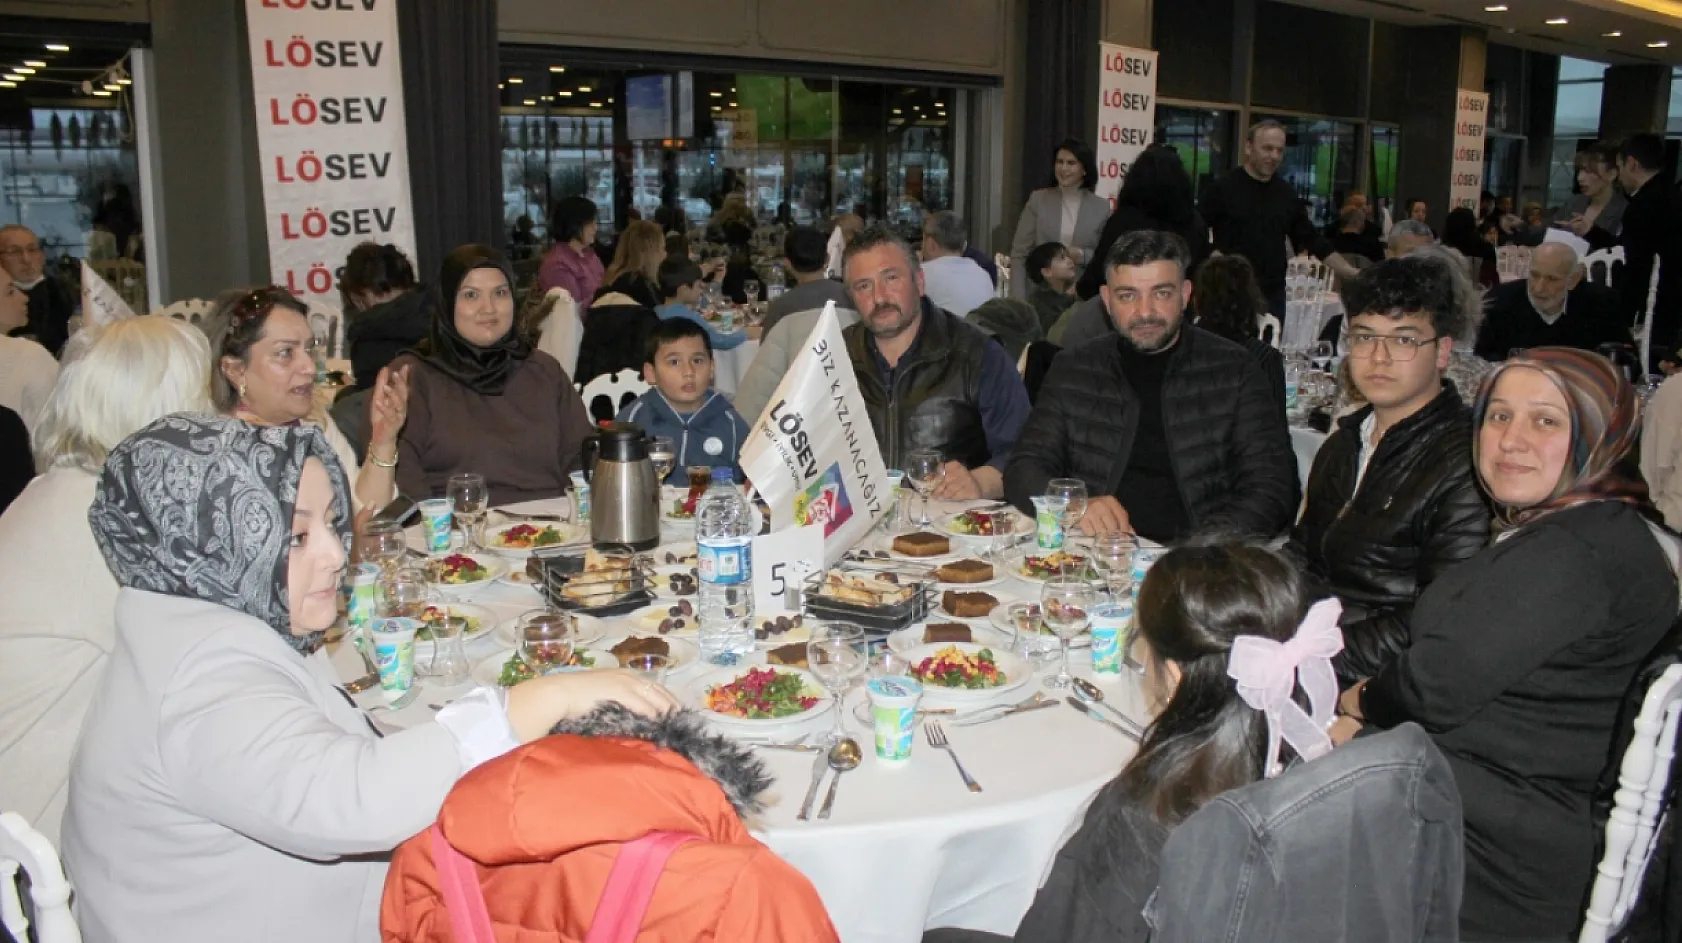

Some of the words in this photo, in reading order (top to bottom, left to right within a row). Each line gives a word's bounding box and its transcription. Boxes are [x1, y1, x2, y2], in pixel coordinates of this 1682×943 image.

[264, 35, 383, 67] LÖSEV
[1105, 52, 1151, 77] LÖSEV
[269, 93, 387, 125] LÖSEV
[1103, 88, 1149, 111] LÖSEV
[1101, 124, 1148, 146] LÖSEV
[275, 150, 391, 183] LÖSEV
[280, 207, 396, 240] LÖSEV
[769, 399, 818, 481] LÖSEV
[830, 378, 882, 520] KAZANACAĞIZ
[770, 561, 787, 596] 5
